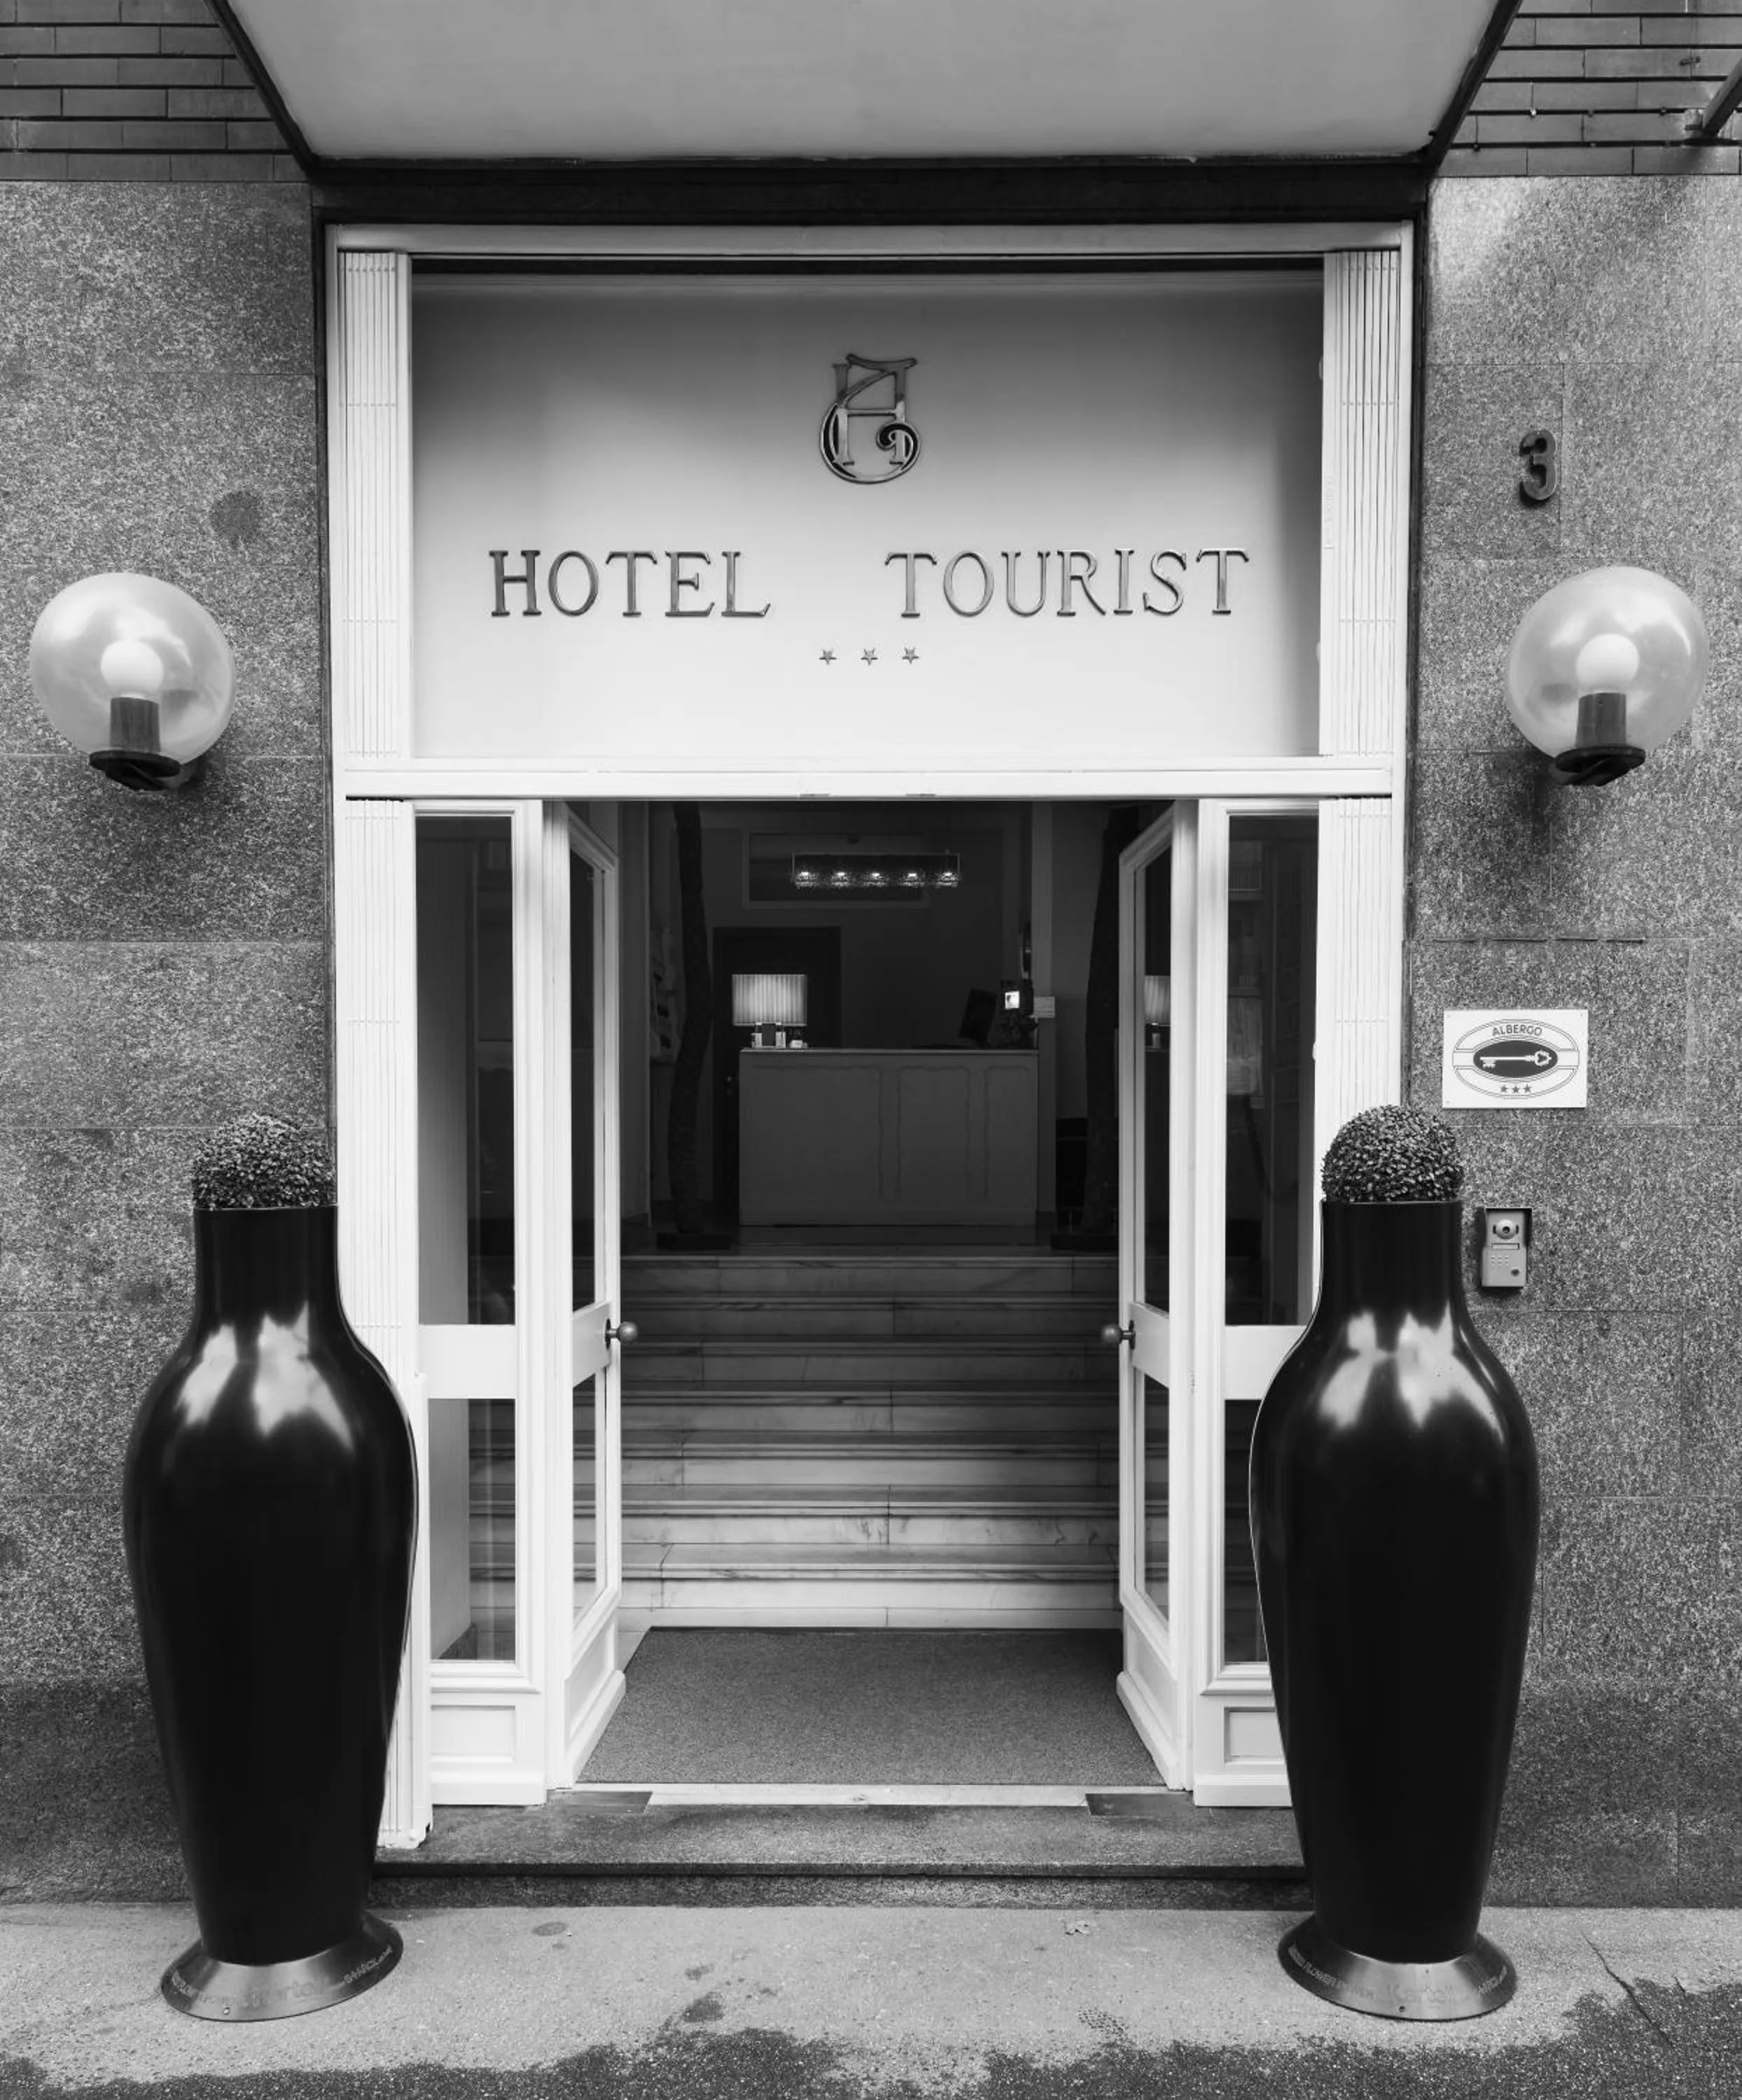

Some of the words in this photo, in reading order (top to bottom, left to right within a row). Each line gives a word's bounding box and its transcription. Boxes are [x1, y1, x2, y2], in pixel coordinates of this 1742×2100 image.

[1520, 428, 1556, 503] 3
[488, 550, 771, 617] HOTEL
[884, 547, 1249, 617] TOURIST
[1492, 1024, 1542, 1037] ALBERGO
